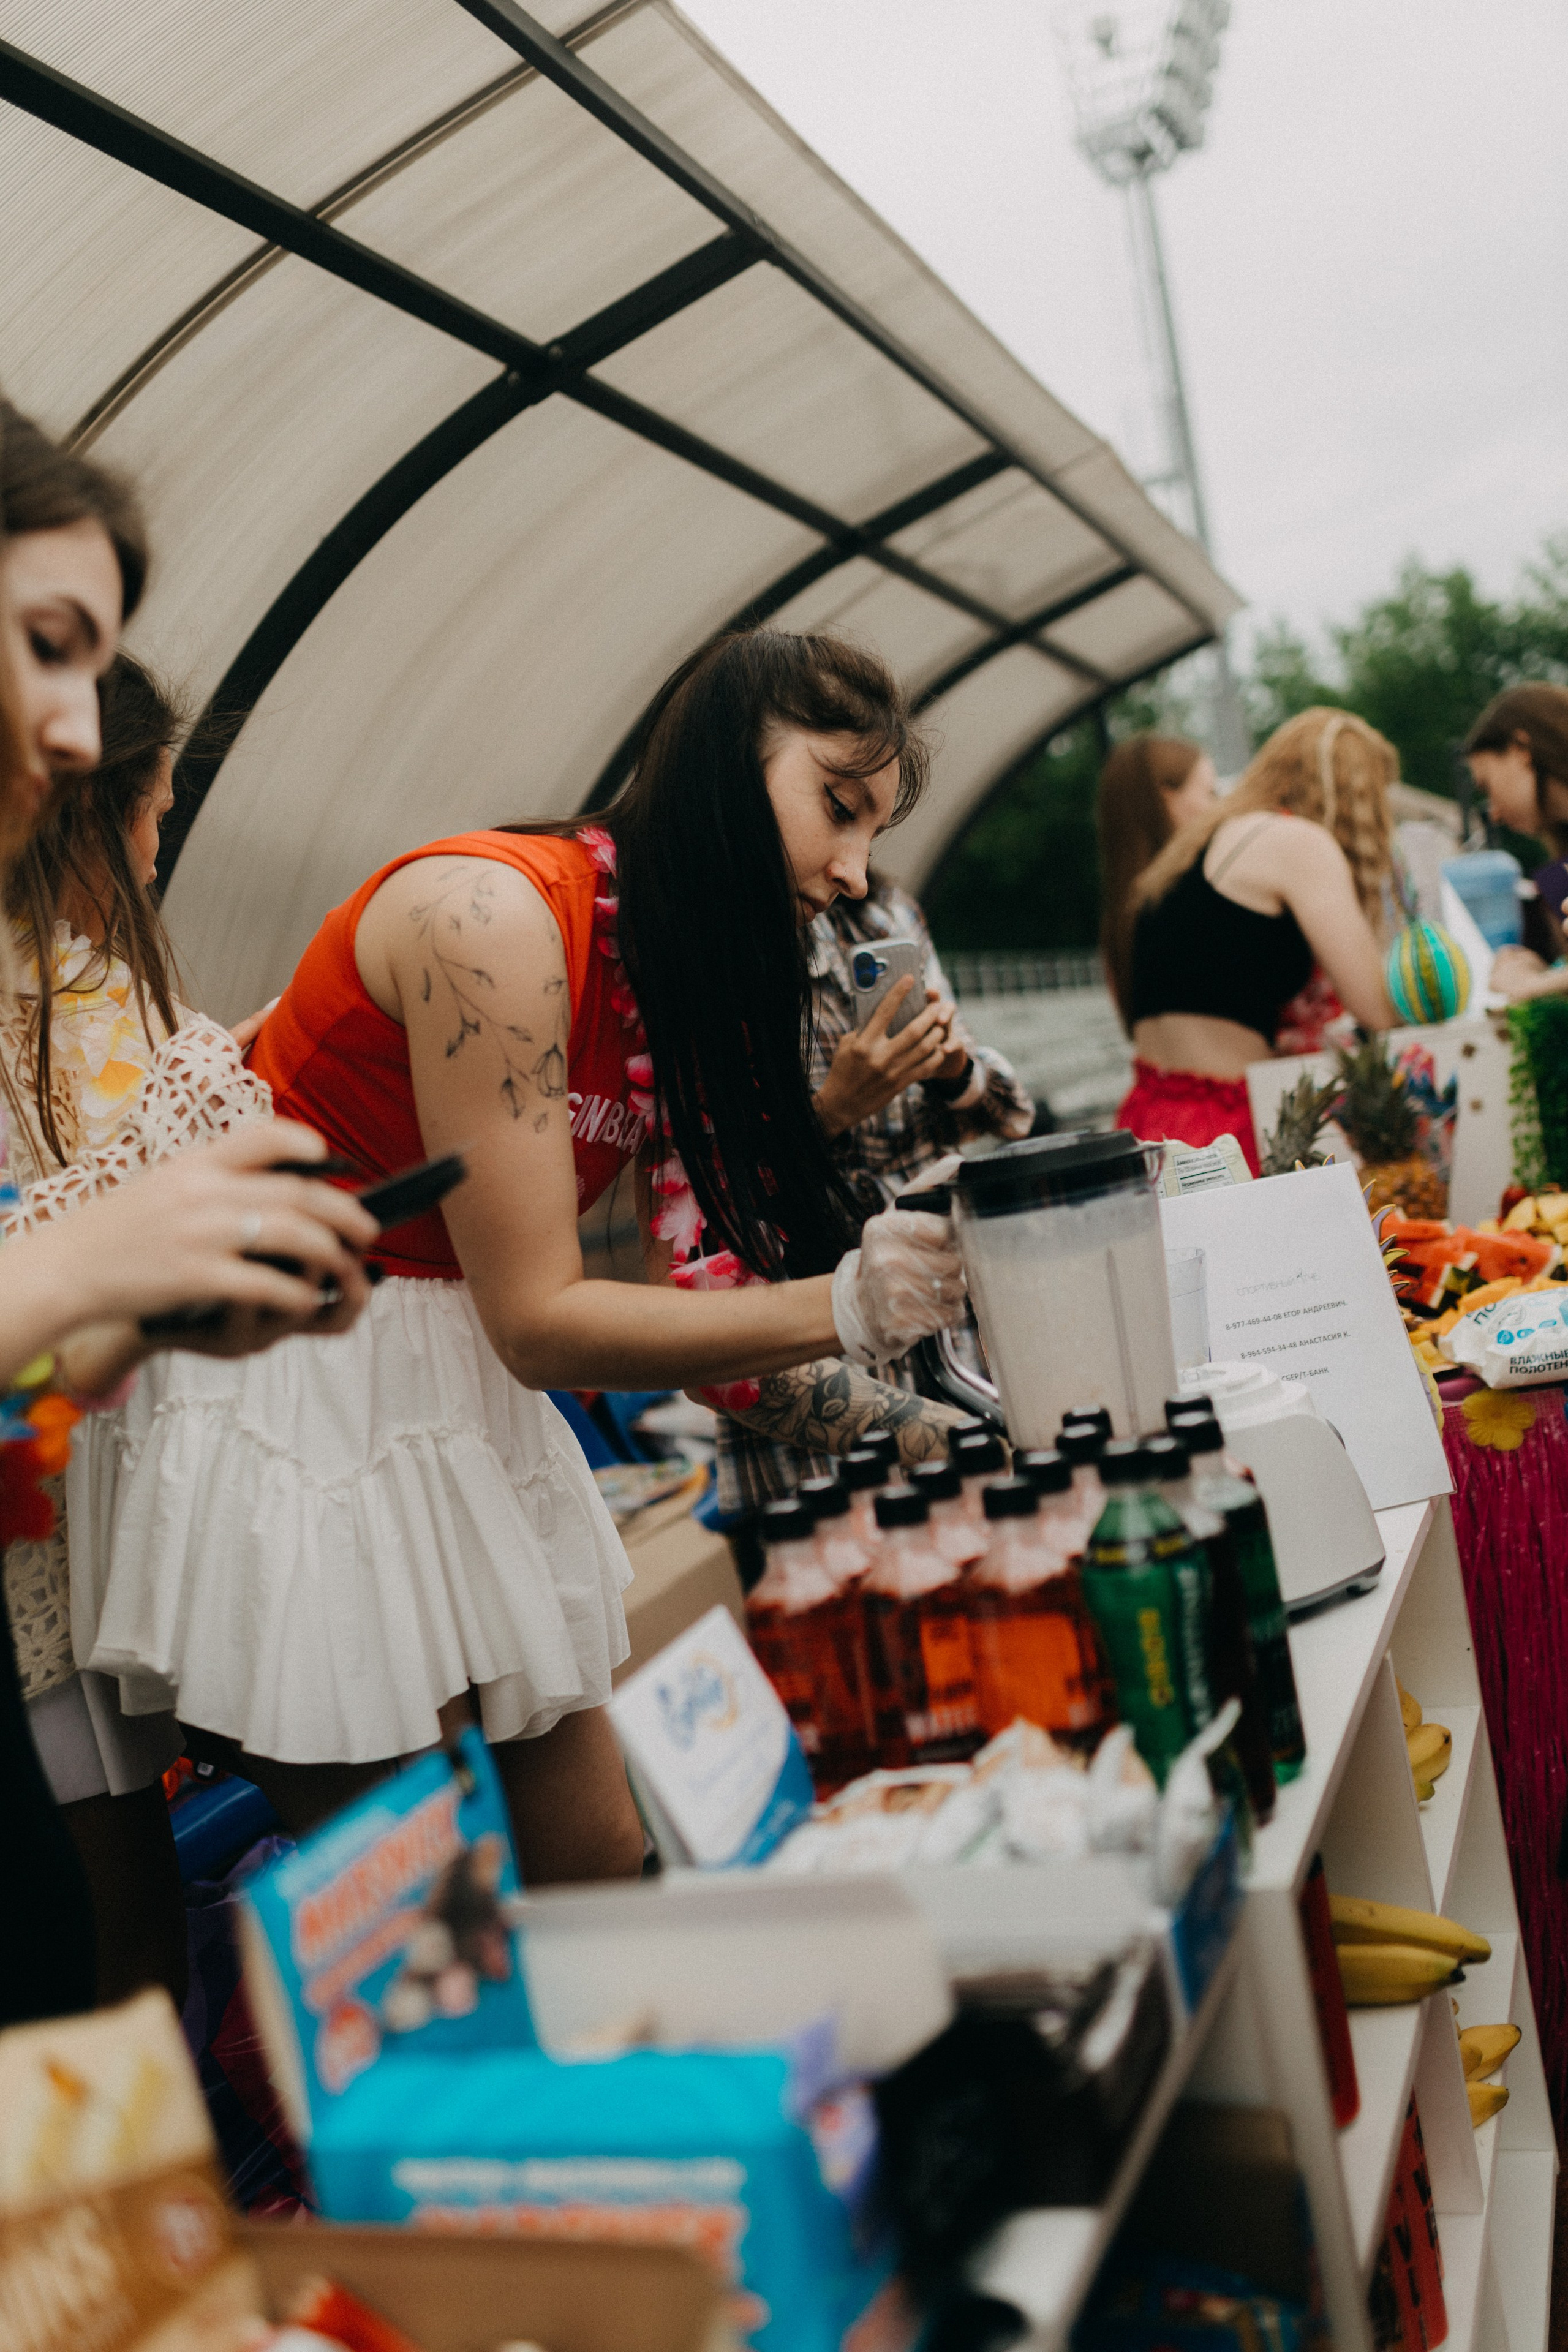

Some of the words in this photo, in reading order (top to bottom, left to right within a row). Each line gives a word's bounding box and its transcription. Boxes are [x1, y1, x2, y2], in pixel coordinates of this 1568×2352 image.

[1284, 1309, 1301, 1319] ЕГОР
[1298, 1331, 1342, 1347] АНАСТАСИЯ
[1281, 1366, 1329, 1381] СБЕР/Т-БАНК
